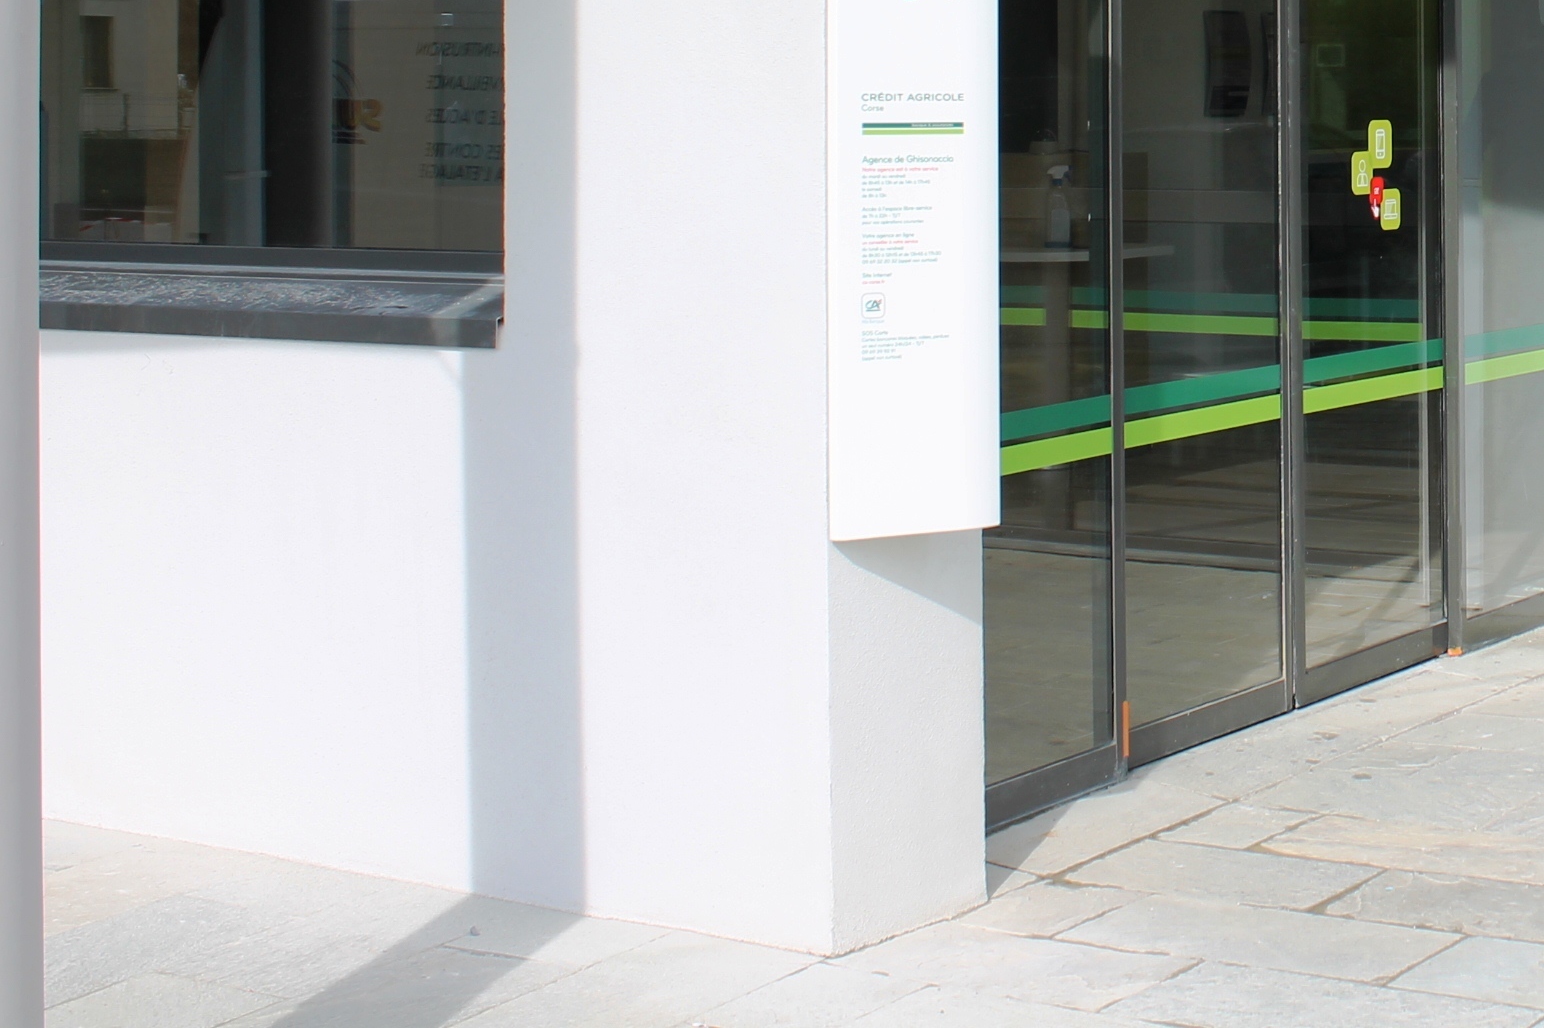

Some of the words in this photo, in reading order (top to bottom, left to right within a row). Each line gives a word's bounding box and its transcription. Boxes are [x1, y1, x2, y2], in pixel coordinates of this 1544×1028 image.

[861, 92, 904, 102] CRÉDIT
[906, 93, 965, 102] AGRICOLE
[861, 104, 884, 112] Corse
[862, 155, 893, 166] Agence
[894, 155, 904, 164] de
